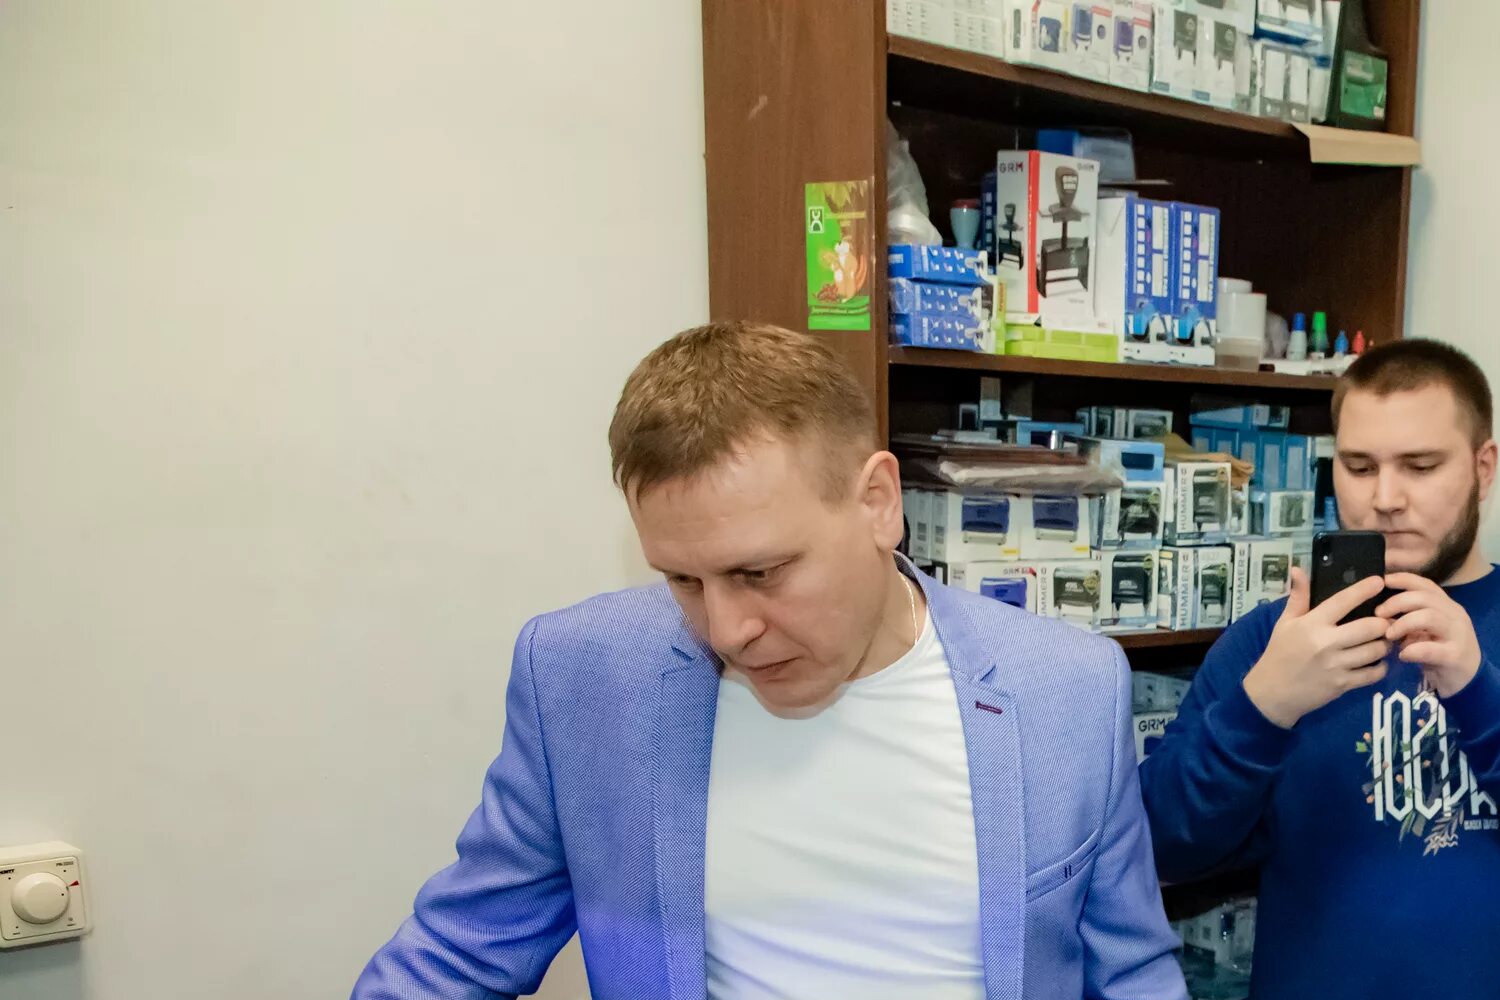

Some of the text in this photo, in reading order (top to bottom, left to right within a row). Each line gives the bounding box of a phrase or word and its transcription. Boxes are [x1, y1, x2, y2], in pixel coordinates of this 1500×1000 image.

[999, 161, 1025, 174] GRM
[1180, 477, 1188, 531] HUMMER
[1180, 564, 1190, 627] HUMMER
[1138, 719, 1166, 733] GRM
